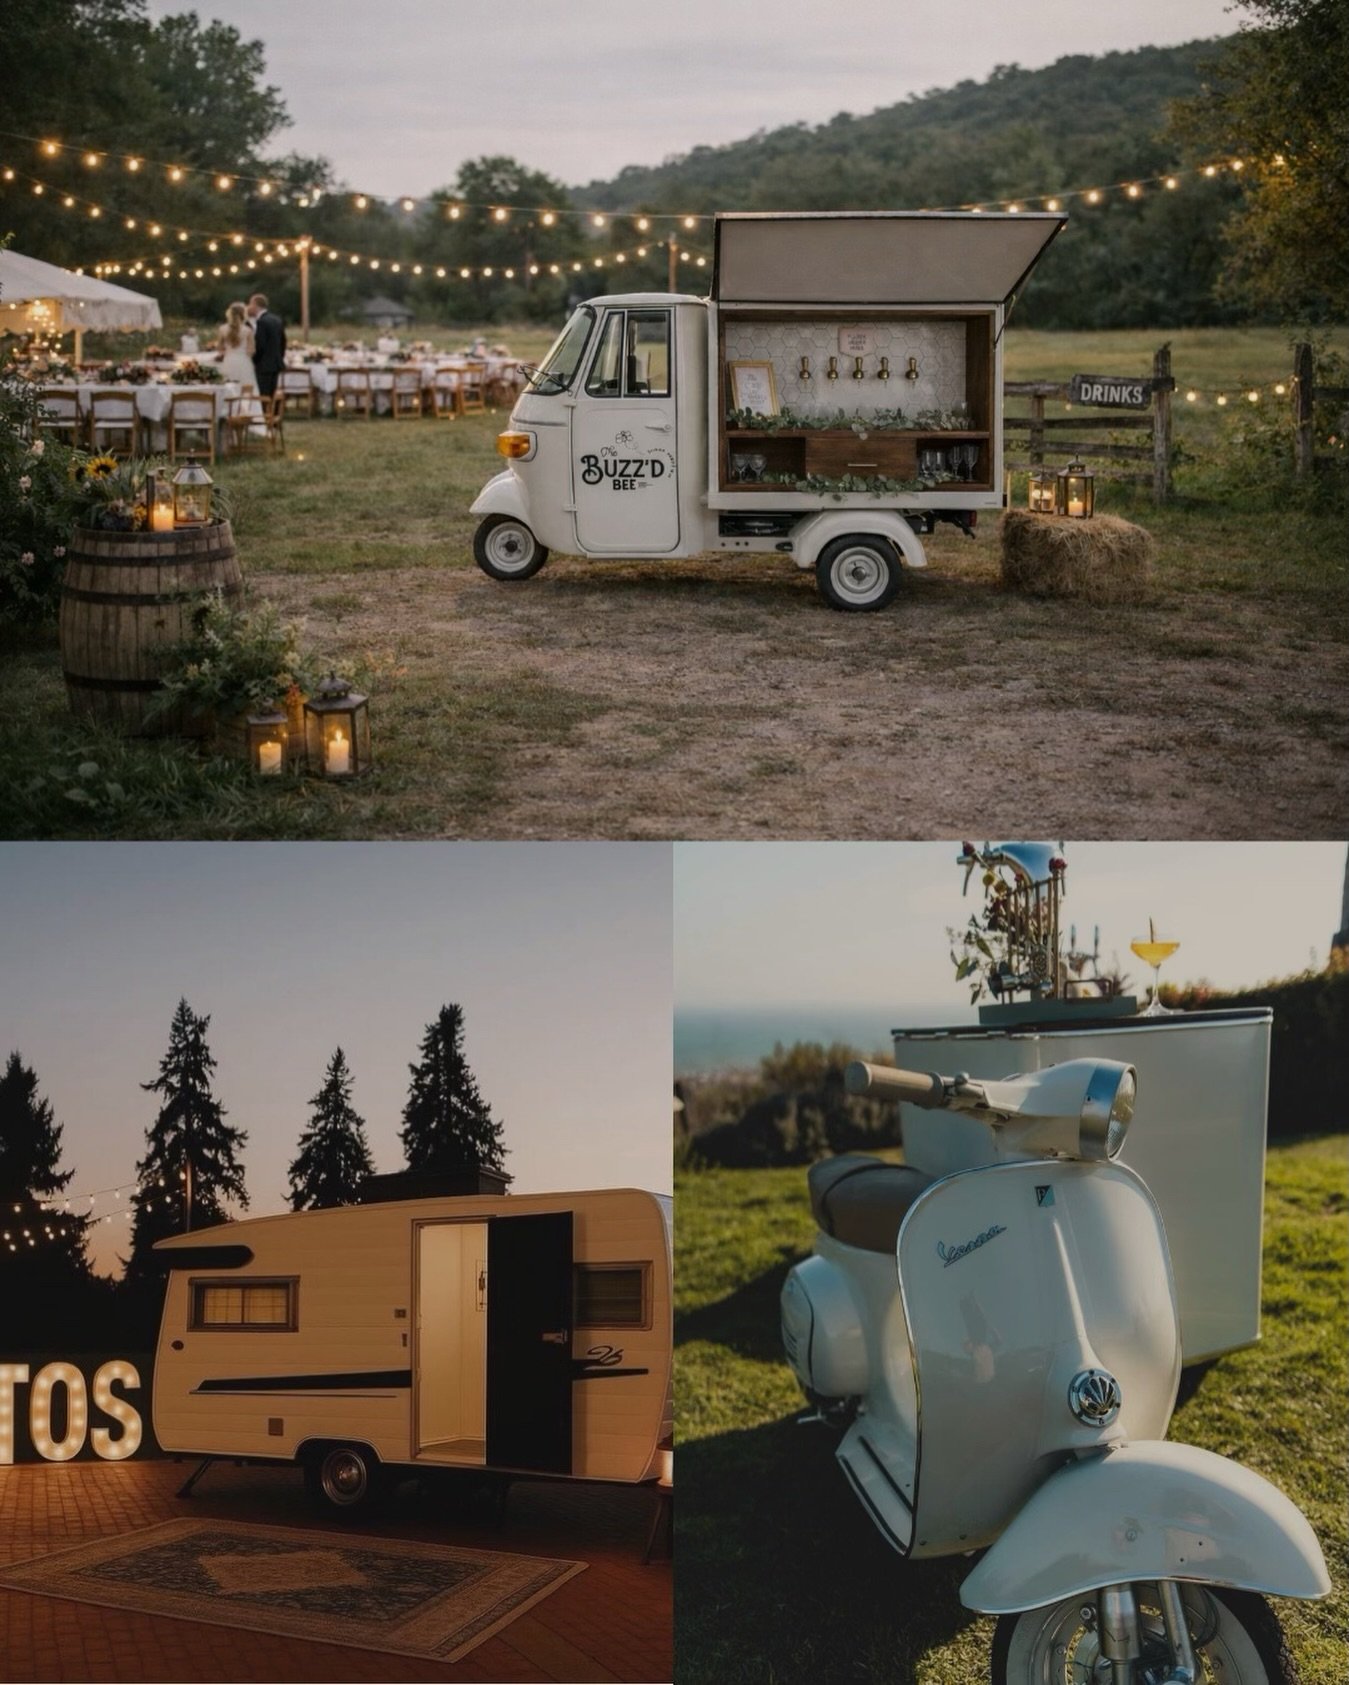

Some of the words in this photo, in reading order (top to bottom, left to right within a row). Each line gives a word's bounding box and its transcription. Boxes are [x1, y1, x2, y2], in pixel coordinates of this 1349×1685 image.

[1080, 383, 1143, 404] DRINKS
[580, 454, 665, 485] BUZZ'D
[612, 479, 636, 491] BEE
